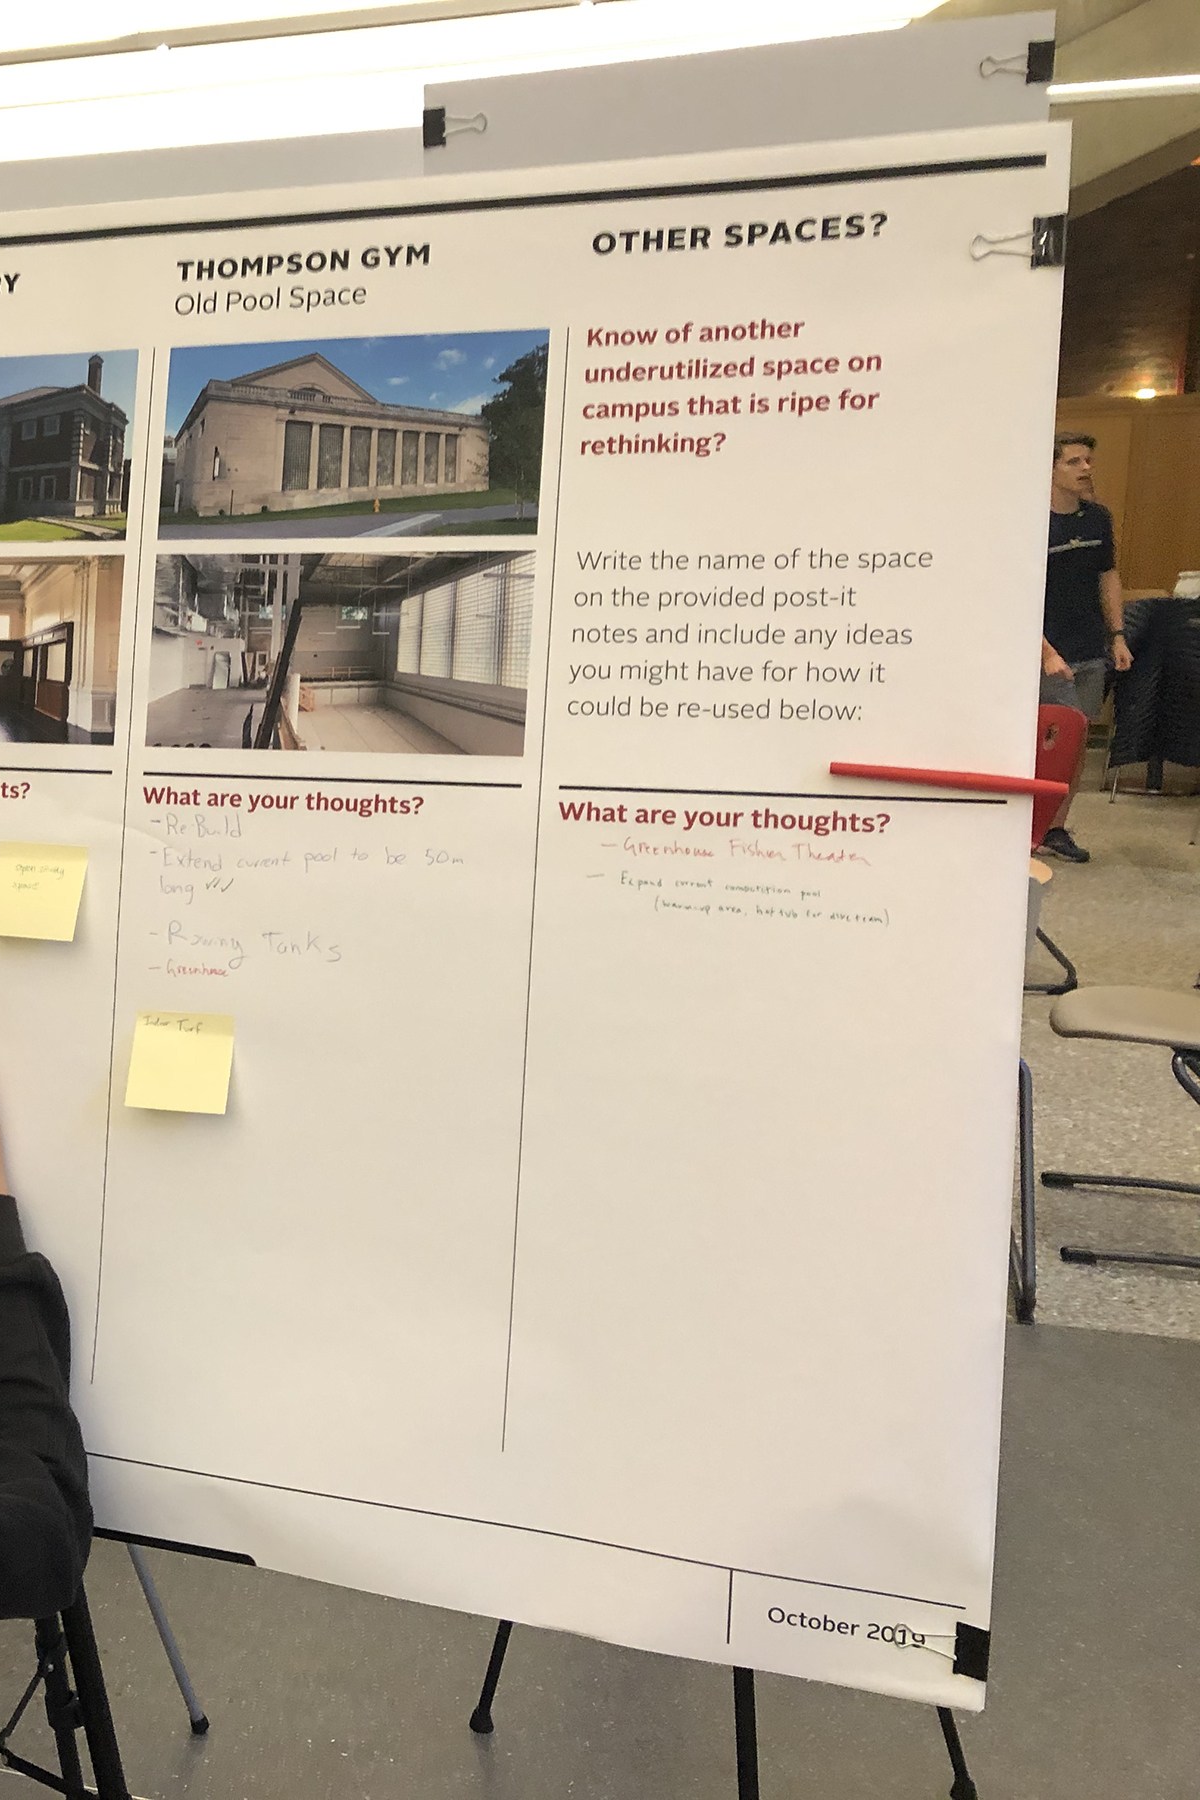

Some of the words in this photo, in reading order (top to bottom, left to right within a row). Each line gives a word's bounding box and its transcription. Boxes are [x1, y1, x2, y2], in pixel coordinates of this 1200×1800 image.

[593, 226, 710, 255] OTHER
[725, 212, 887, 248] SPACES?
[177, 249, 349, 281] THOMPSON
[361, 243, 430, 269] GYM
[175, 290, 217, 315] Old
[227, 286, 280, 312] Pool
[290, 286, 366, 312] Space
[588, 327, 658, 347] Know
[665, 322, 693, 344] of
[699, 318, 805, 342] another
[585, 356, 754, 383] underutilized
[763, 357, 839, 380] space
[848, 355, 881, 372] on
[583, 400, 679, 422] campus
[687, 394, 741, 415] that
[750, 392, 769, 413] is
[778, 391, 830, 416] ripe
[839, 388, 880, 410] for
[581, 431, 726, 457] rethinking?
[577, 549, 641, 570] Write
[651, 549, 688, 570] the
[699, 554, 765, 570] name
[775, 547, 801, 569] of
[809, 547, 848, 569] the
[858, 551, 932, 573] space
[574, 591, 602, 607] on
[612, 585, 649, 606] the
[659, 585, 764, 611] provided
[774, 587, 856, 611] post-it
[573, 624, 637, 643] notes
[646, 622, 688, 644] and
[698, 623, 785, 644] include
[795, 628, 837, 649] any
[847, 622, 912, 644] ideas
[569, 664, 610, 684] you
[621, 659, 688, 685] might
[698, 659, 753, 681] have
[762, 660, 797, 682] for
[807, 660, 860, 682] how
[870, 663, 885, 683] it
[568, 695, 631, 716] could
[641, 695, 668, 717] be
[678, 697, 770, 719] re-used
[780, 698, 861, 720] below:
[143, 785, 200, 805] What
[207, 792, 242, 807] are
[248, 794, 299, 813] your
[305, 791, 424, 817] thoughts?
[559, 801, 627, 823] What
[635, 808, 676, 825] are
[683, 810, 744, 831] your
[751, 807, 890, 836] thoughts?
[304, 848, 337, 873] pool
[351, 851, 369, 861] to
[385, 847, 406, 865] be
[800, 890, 821, 900] pool
[768, 1606, 860, 1635] October
[866, 1622, 925, 1648] 2019
